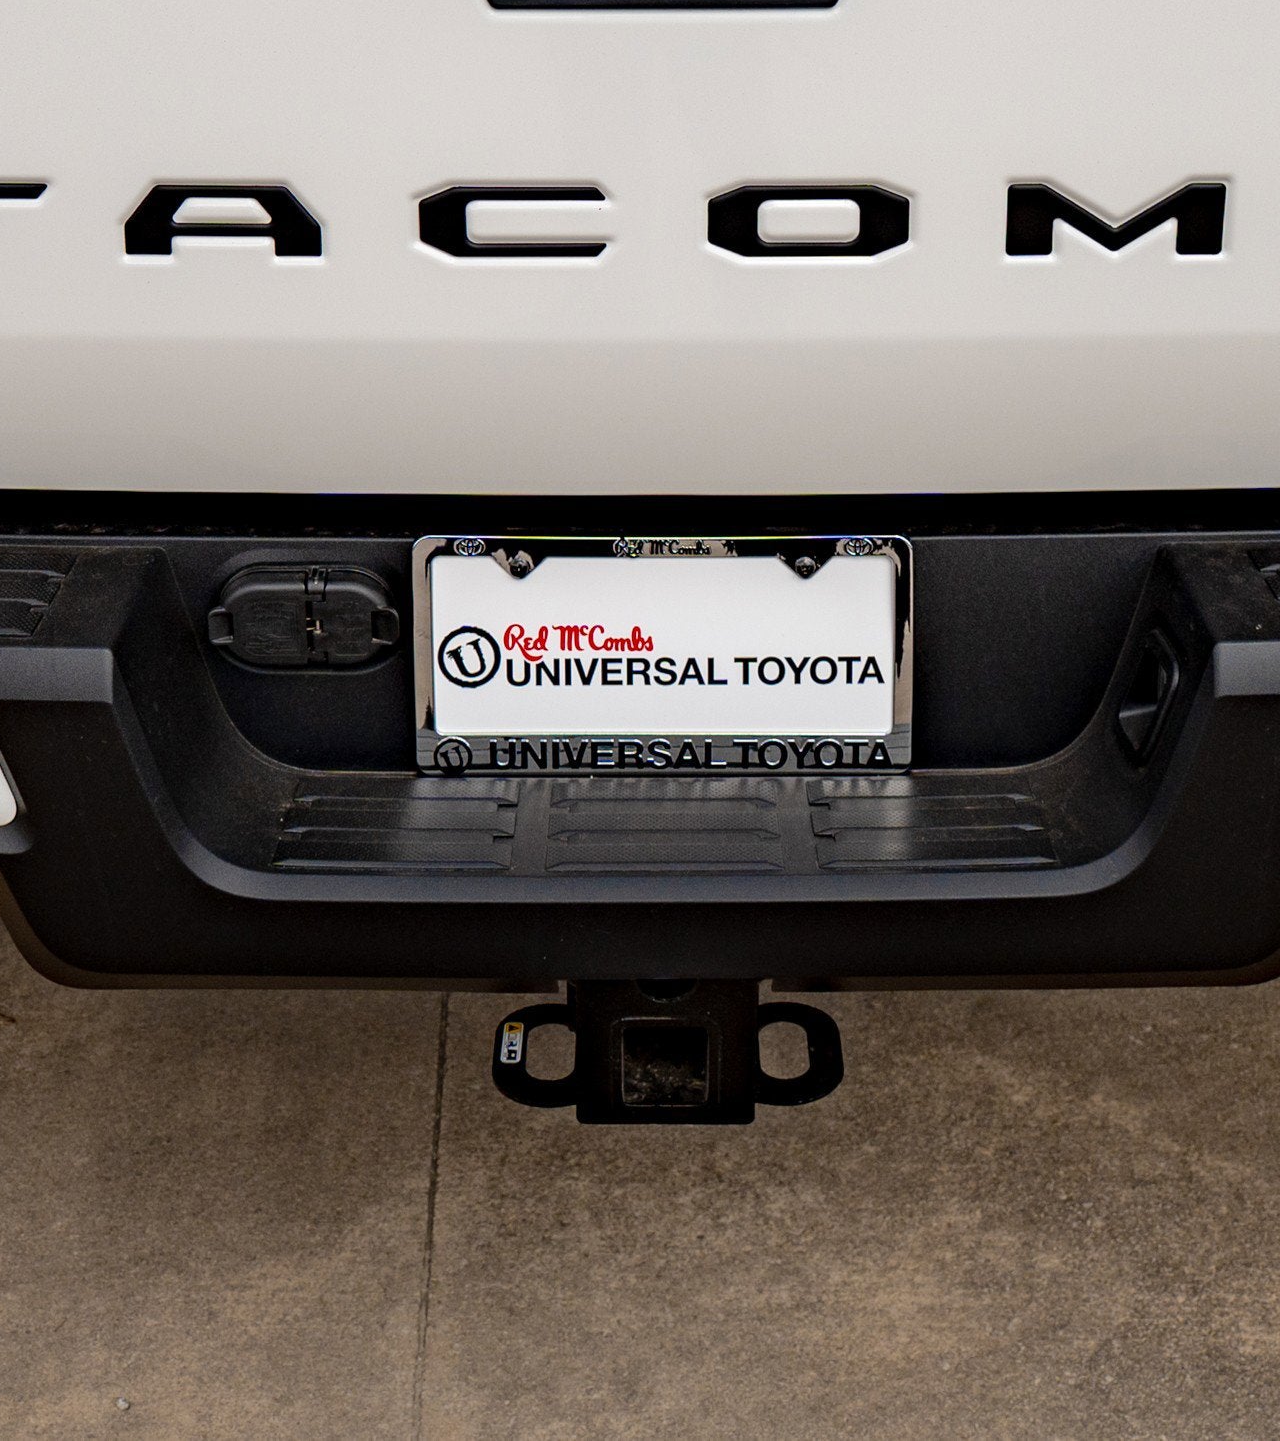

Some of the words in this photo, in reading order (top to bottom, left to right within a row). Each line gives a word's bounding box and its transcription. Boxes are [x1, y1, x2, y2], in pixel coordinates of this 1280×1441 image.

[503, 623, 549, 662] Red
[552, 624, 654, 652] McCombs
[506, 656, 728, 687] UNIVERSAL
[734, 655, 885, 686] TOYOTA
[489, 738, 727, 770] UNIVERSAL
[732, 738, 894, 770] TOYOTA
